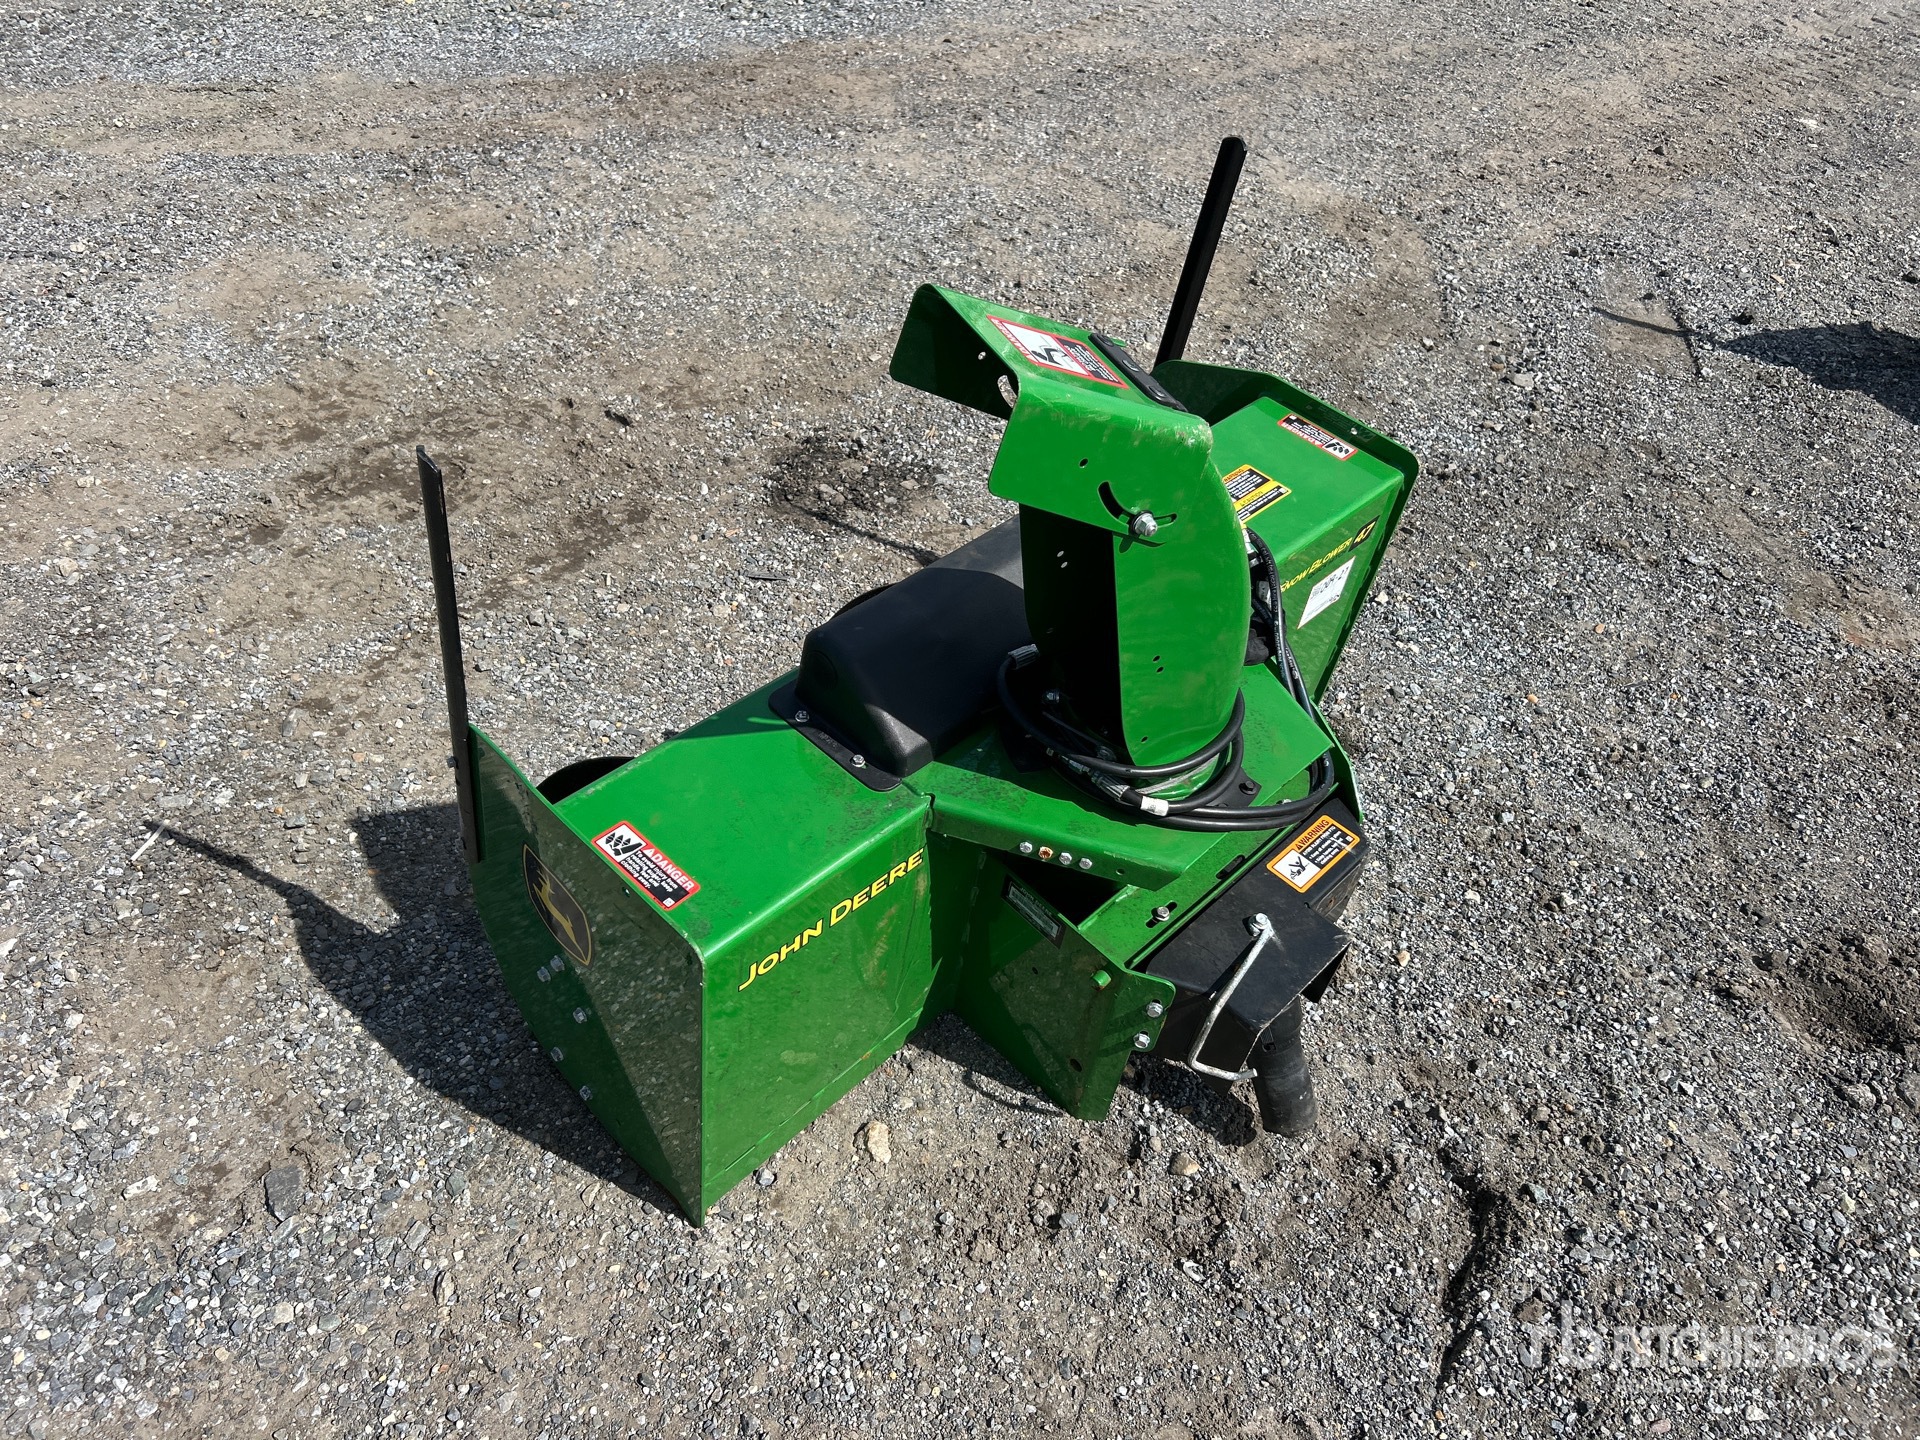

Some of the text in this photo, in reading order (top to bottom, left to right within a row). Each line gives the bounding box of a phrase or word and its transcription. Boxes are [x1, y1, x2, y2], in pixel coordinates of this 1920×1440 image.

[1281, 421, 1316, 444] DANGER
[1353, 521, 1376, 543] 47
[1280, 566, 1310, 593] SNOW
[1308, 536, 1353, 573] BLOWER
[1299, 819, 1330, 846] WARNING
[619, 860, 640, 878] clothing
[629, 853, 649, 870] rotating
[659, 880, 673, 892] keep
[639, 869, 651, 879] feet
[647, 877, 659, 887] and
[640, 855, 656, 868] avoid
[652, 866, 668, 880] injury
[665, 877, 678, 889] from
[650, 852, 695, 891] DANGER
[738, 918, 824, 992] JOHN
[829, 848, 925, 928] DEERE
